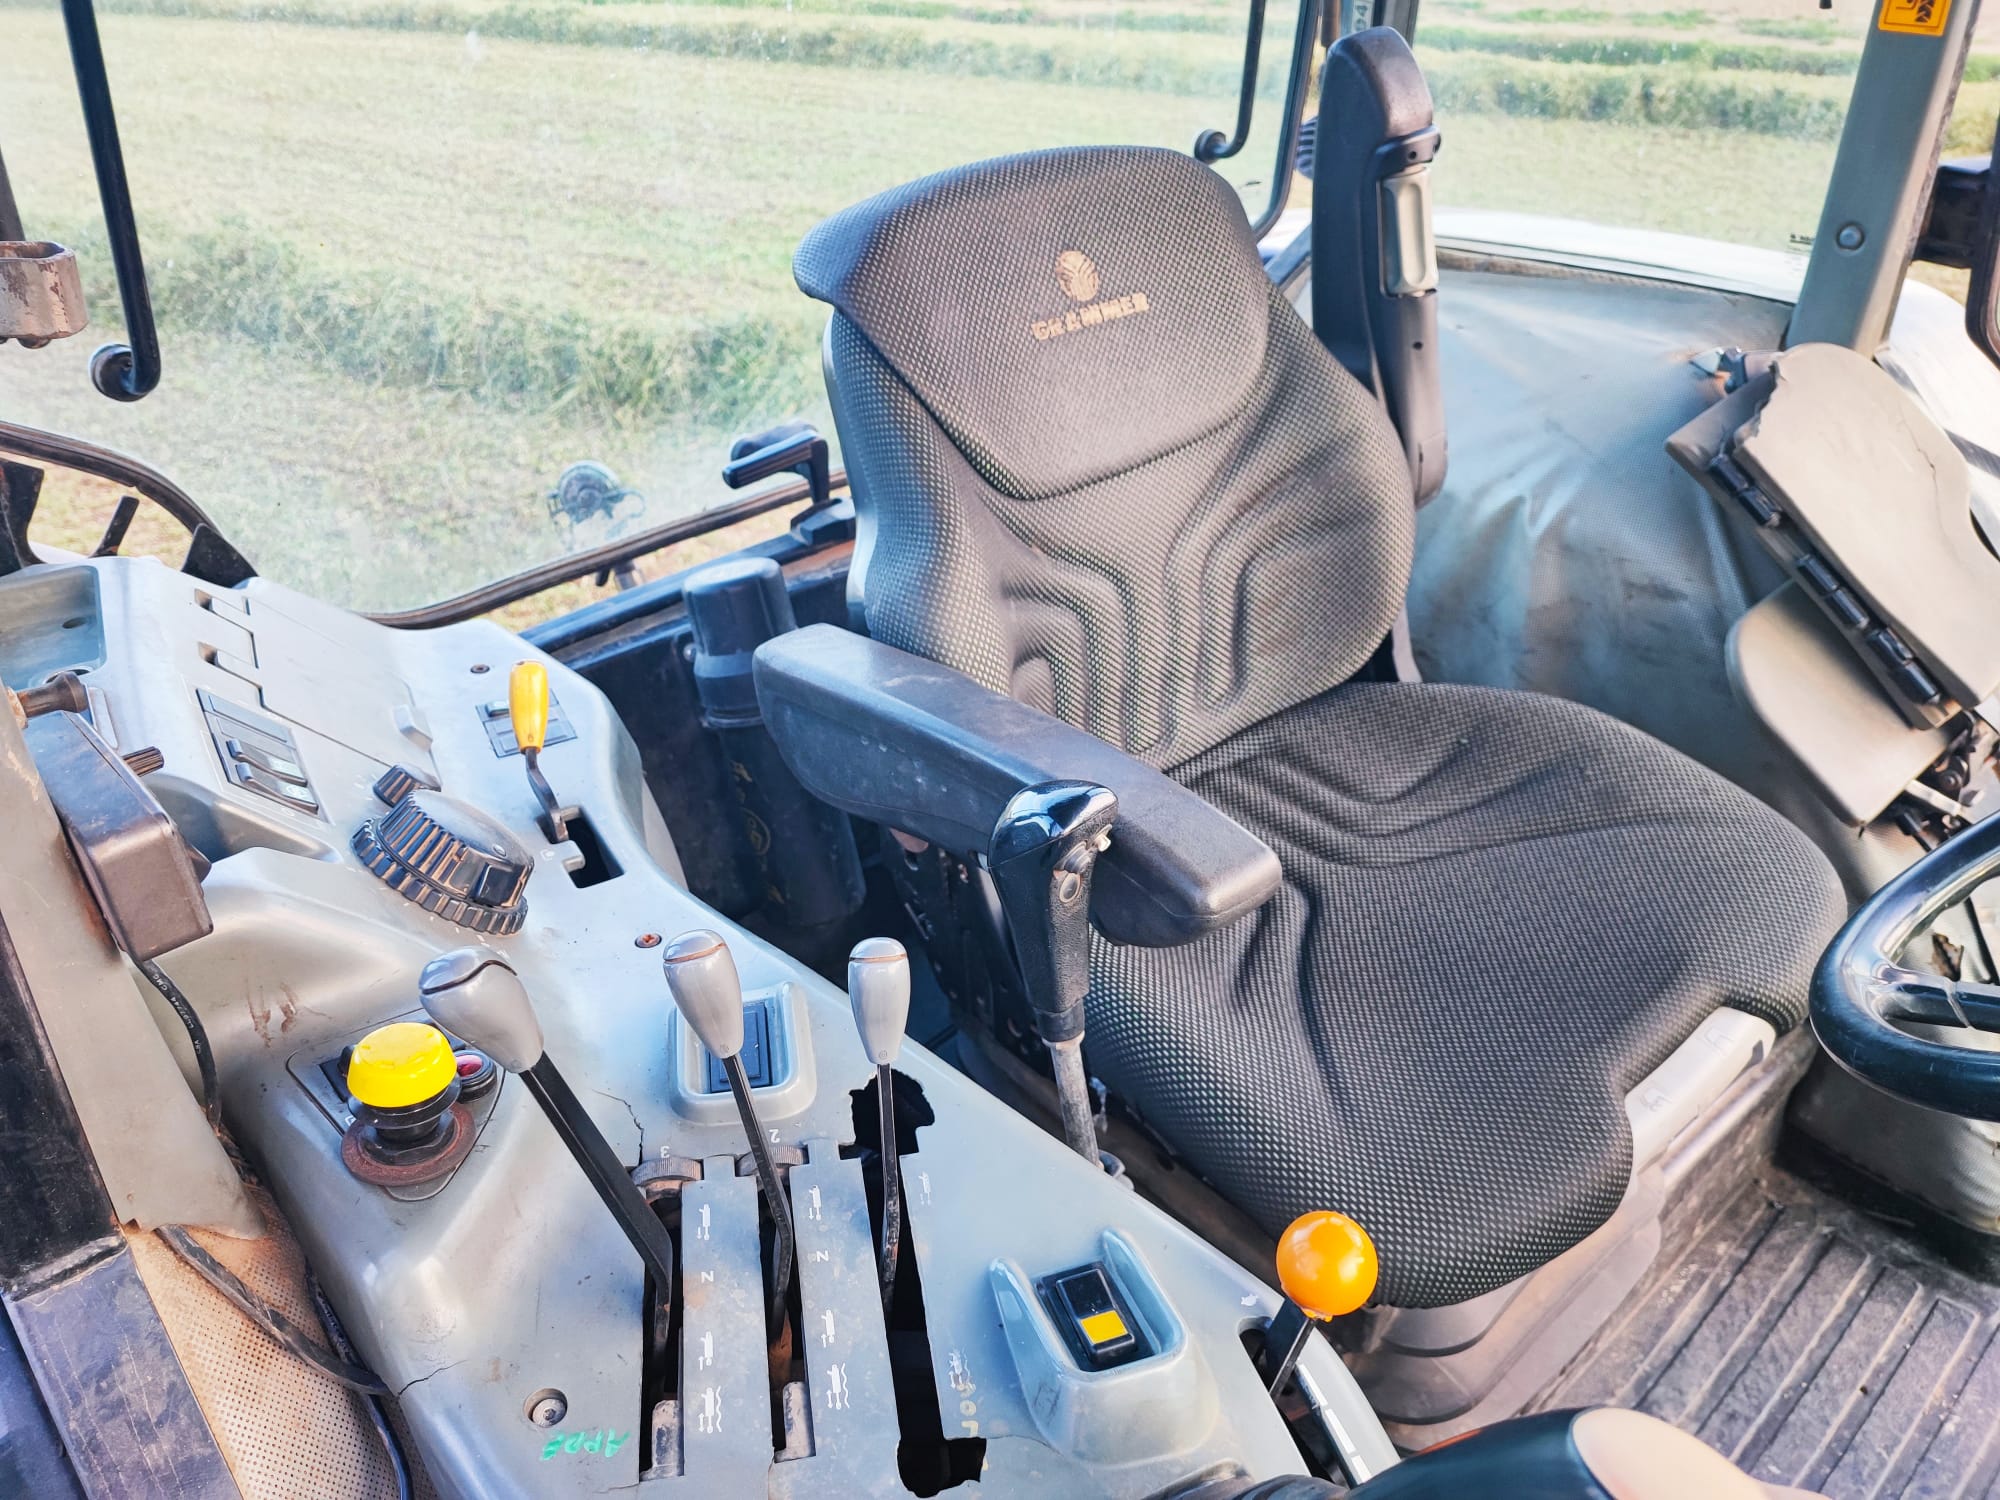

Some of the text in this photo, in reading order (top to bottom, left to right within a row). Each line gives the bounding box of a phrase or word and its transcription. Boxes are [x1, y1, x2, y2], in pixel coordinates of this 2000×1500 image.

[769, 1128, 780, 1143] 2
[660, 1145, 670, 1158] 3
[816, 1250, 829, 1262] N
[701, 1270, 715, 1283] N
